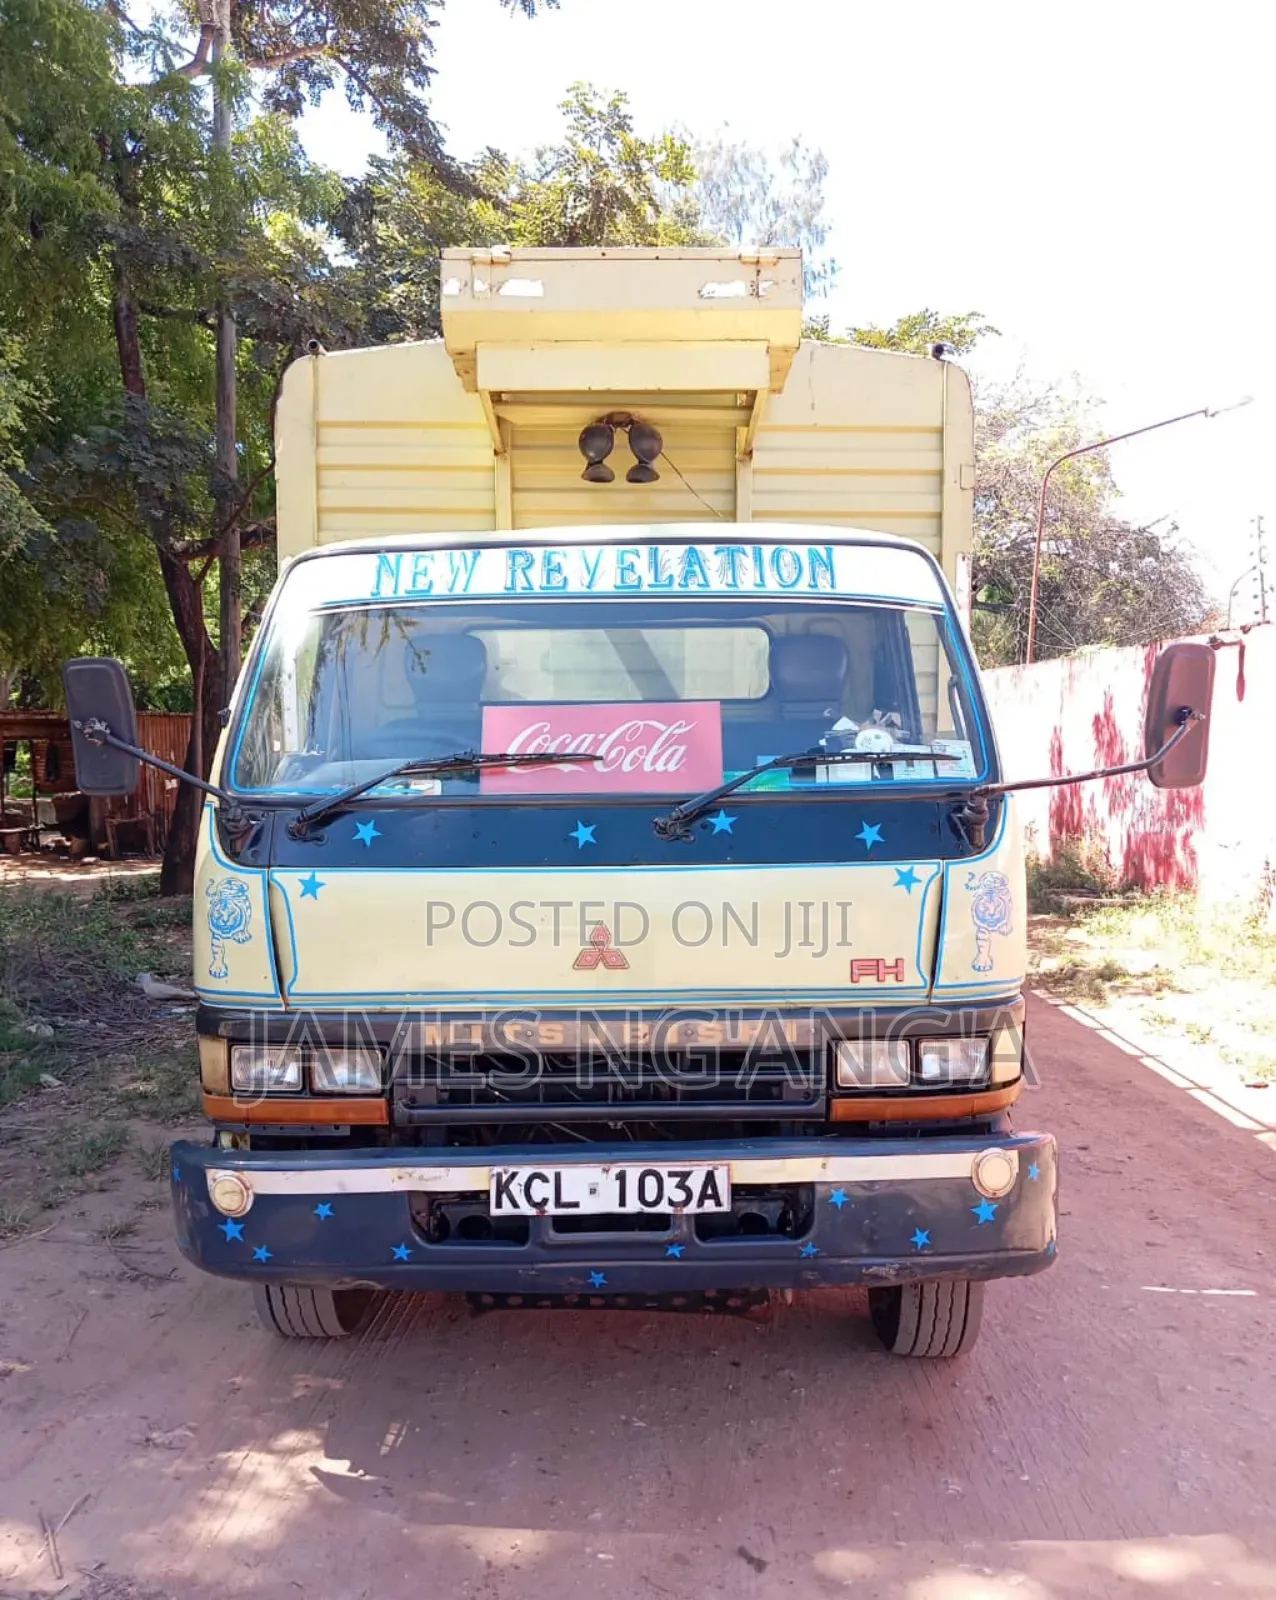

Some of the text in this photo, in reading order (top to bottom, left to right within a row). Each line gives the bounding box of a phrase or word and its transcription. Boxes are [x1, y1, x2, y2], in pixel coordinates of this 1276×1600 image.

[370, 545, 837, 597] NEW REVELATION
[505, 719, 698, 774] Coca-Cola
[850, 958, 905, 984] FH
[494, 1168, 724, 1210] KCL 103A
